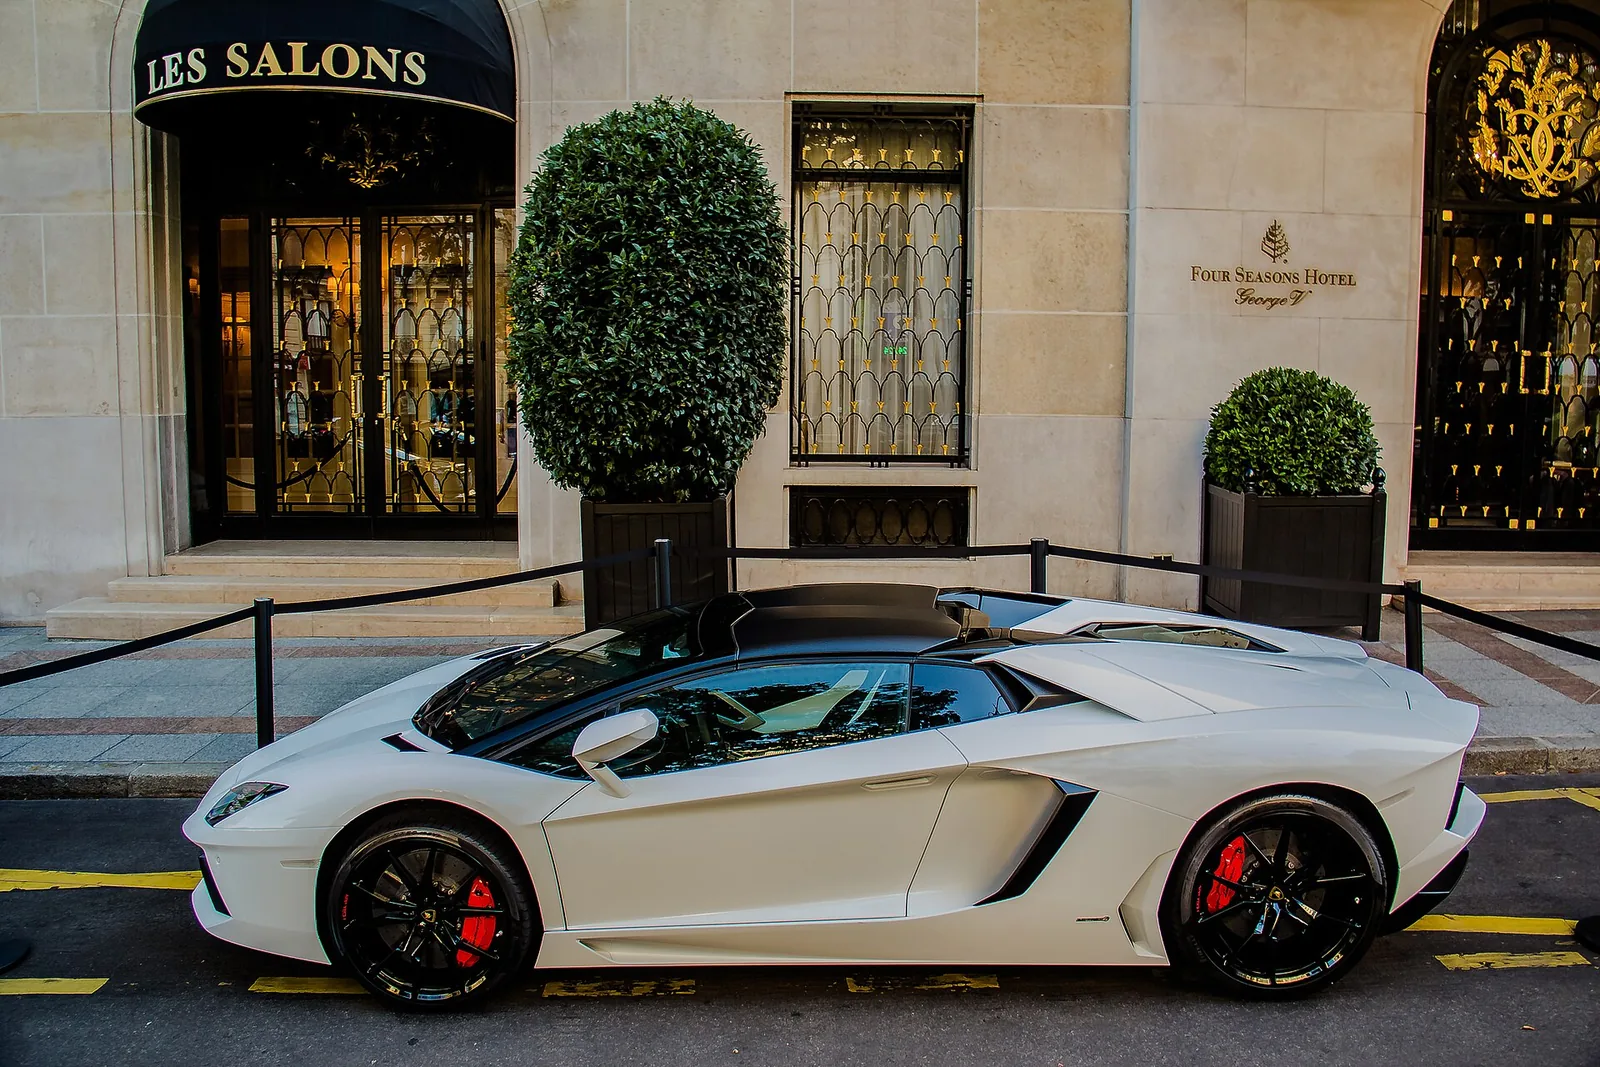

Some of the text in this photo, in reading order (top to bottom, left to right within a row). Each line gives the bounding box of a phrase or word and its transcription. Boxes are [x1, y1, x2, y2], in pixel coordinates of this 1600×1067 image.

[147, 42, 427, 95] LES SALONS
[1190, 265, 1357, 286] FOUR SEASONS HOTEL
[1234, 287, 1313, 310] George V
